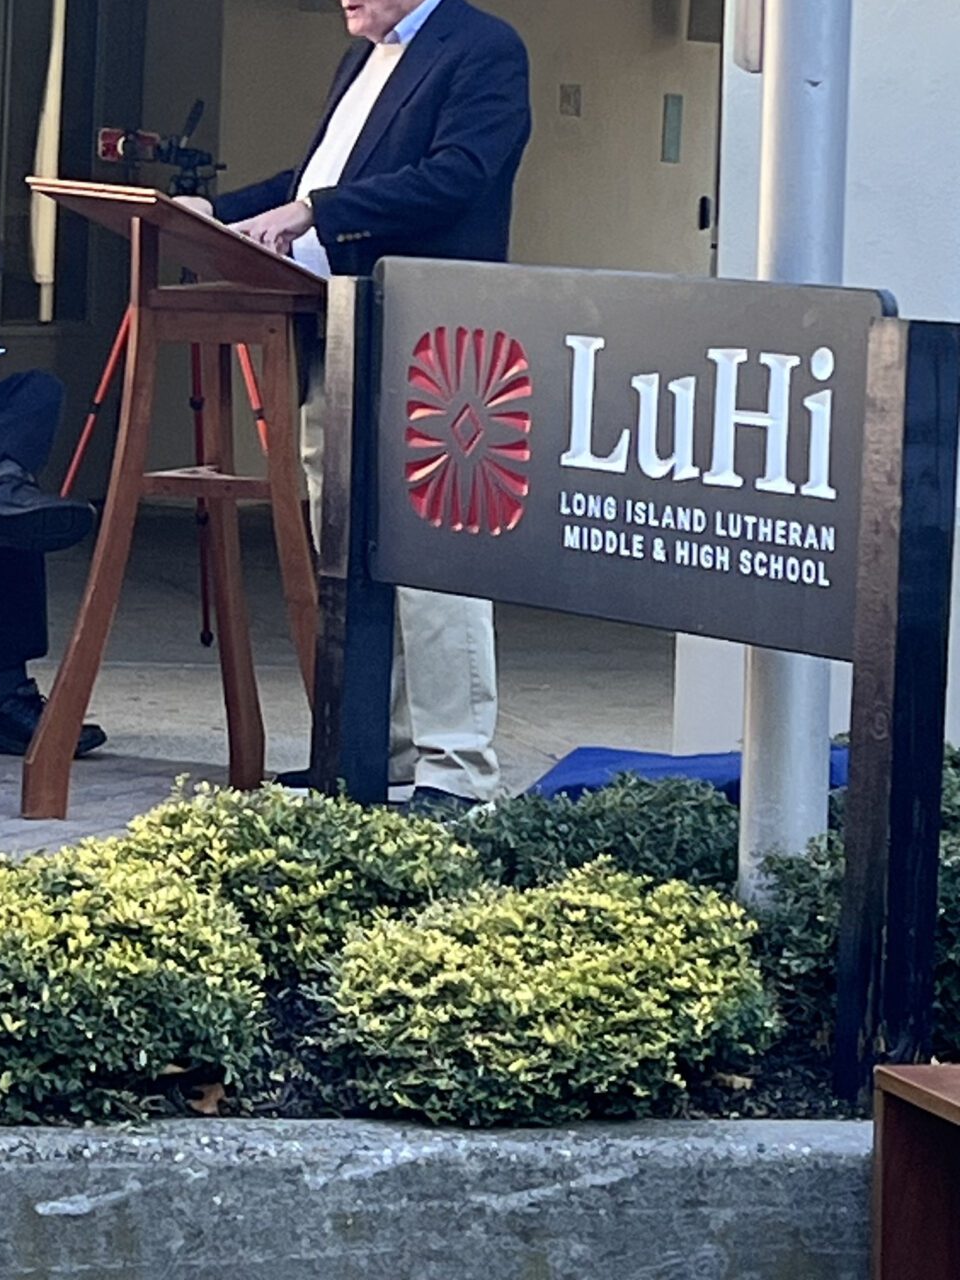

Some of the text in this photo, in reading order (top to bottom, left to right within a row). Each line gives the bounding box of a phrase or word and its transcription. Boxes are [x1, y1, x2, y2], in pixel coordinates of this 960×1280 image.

[560, 334, 837, 500] LuHi
[560, 491, 835, 551] LONG ISLAND LUTHERAN
[564, 525, 830, 587] MIDDLE & HIGH SCHOOL
